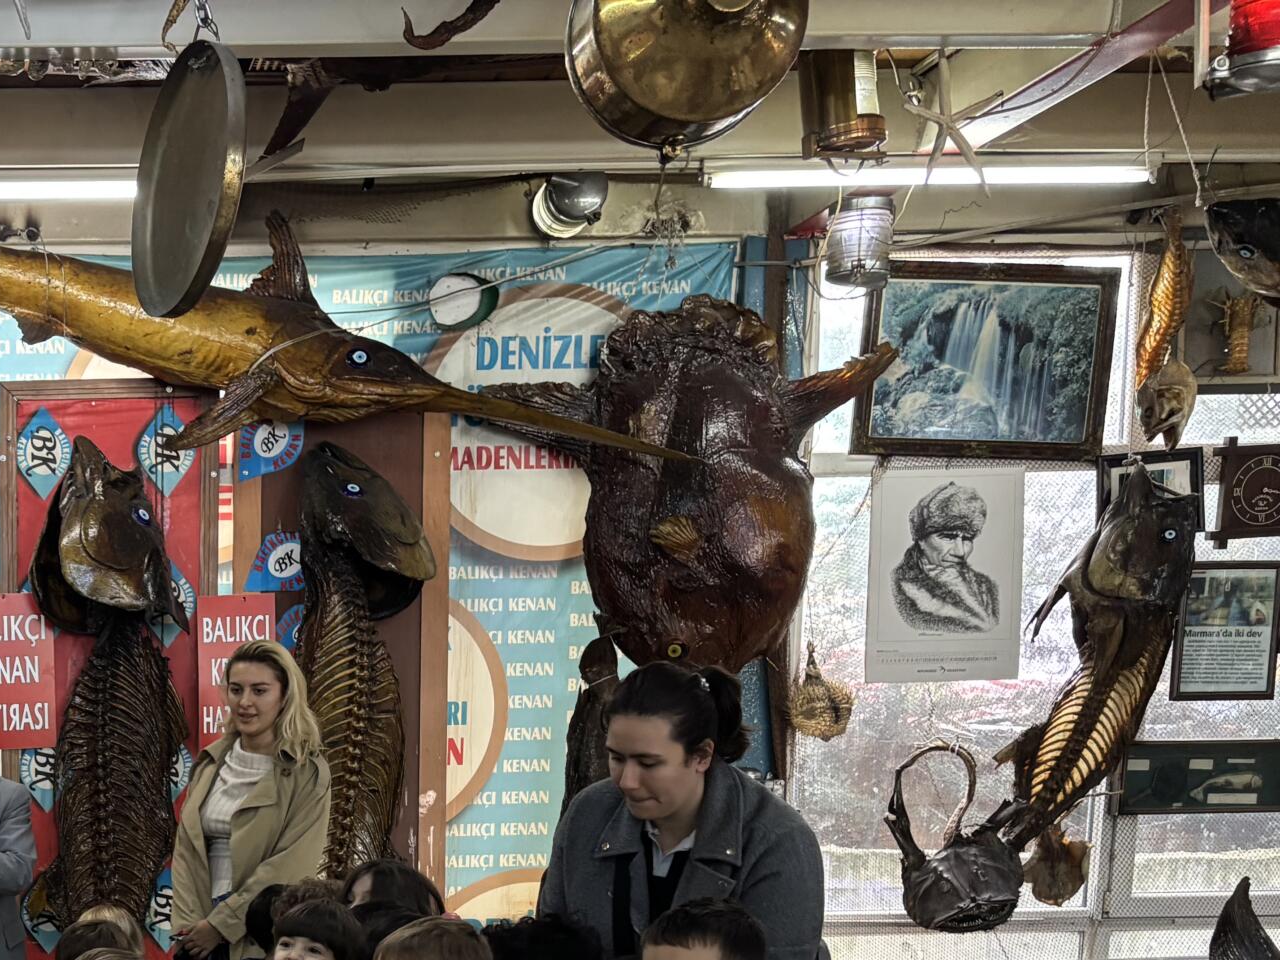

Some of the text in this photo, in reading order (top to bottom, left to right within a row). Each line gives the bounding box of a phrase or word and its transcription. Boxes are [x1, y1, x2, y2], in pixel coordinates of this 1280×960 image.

[332, 289, 388, 307] BALIKÇI
[476, 327, 606, 371] DENİZLE
[449, 564, 558, 583] BALIKÇI KENAN
[508, 598, 557, 612] KENAN
[507, 630, 555, 644] KENAN
[1235, 629, 1244, 637] iki
[1246, 629, 1263, 637] dev
[506, 663, 554, 676] KENAN
[504, 727, 552, 741] KENAN
[503, 759, 550, 773] KENAN
[502, 791, 549, 804] KENAN
[500, 822, 548, 836] KENAN
[499, 854, 547, 867] KENAN
